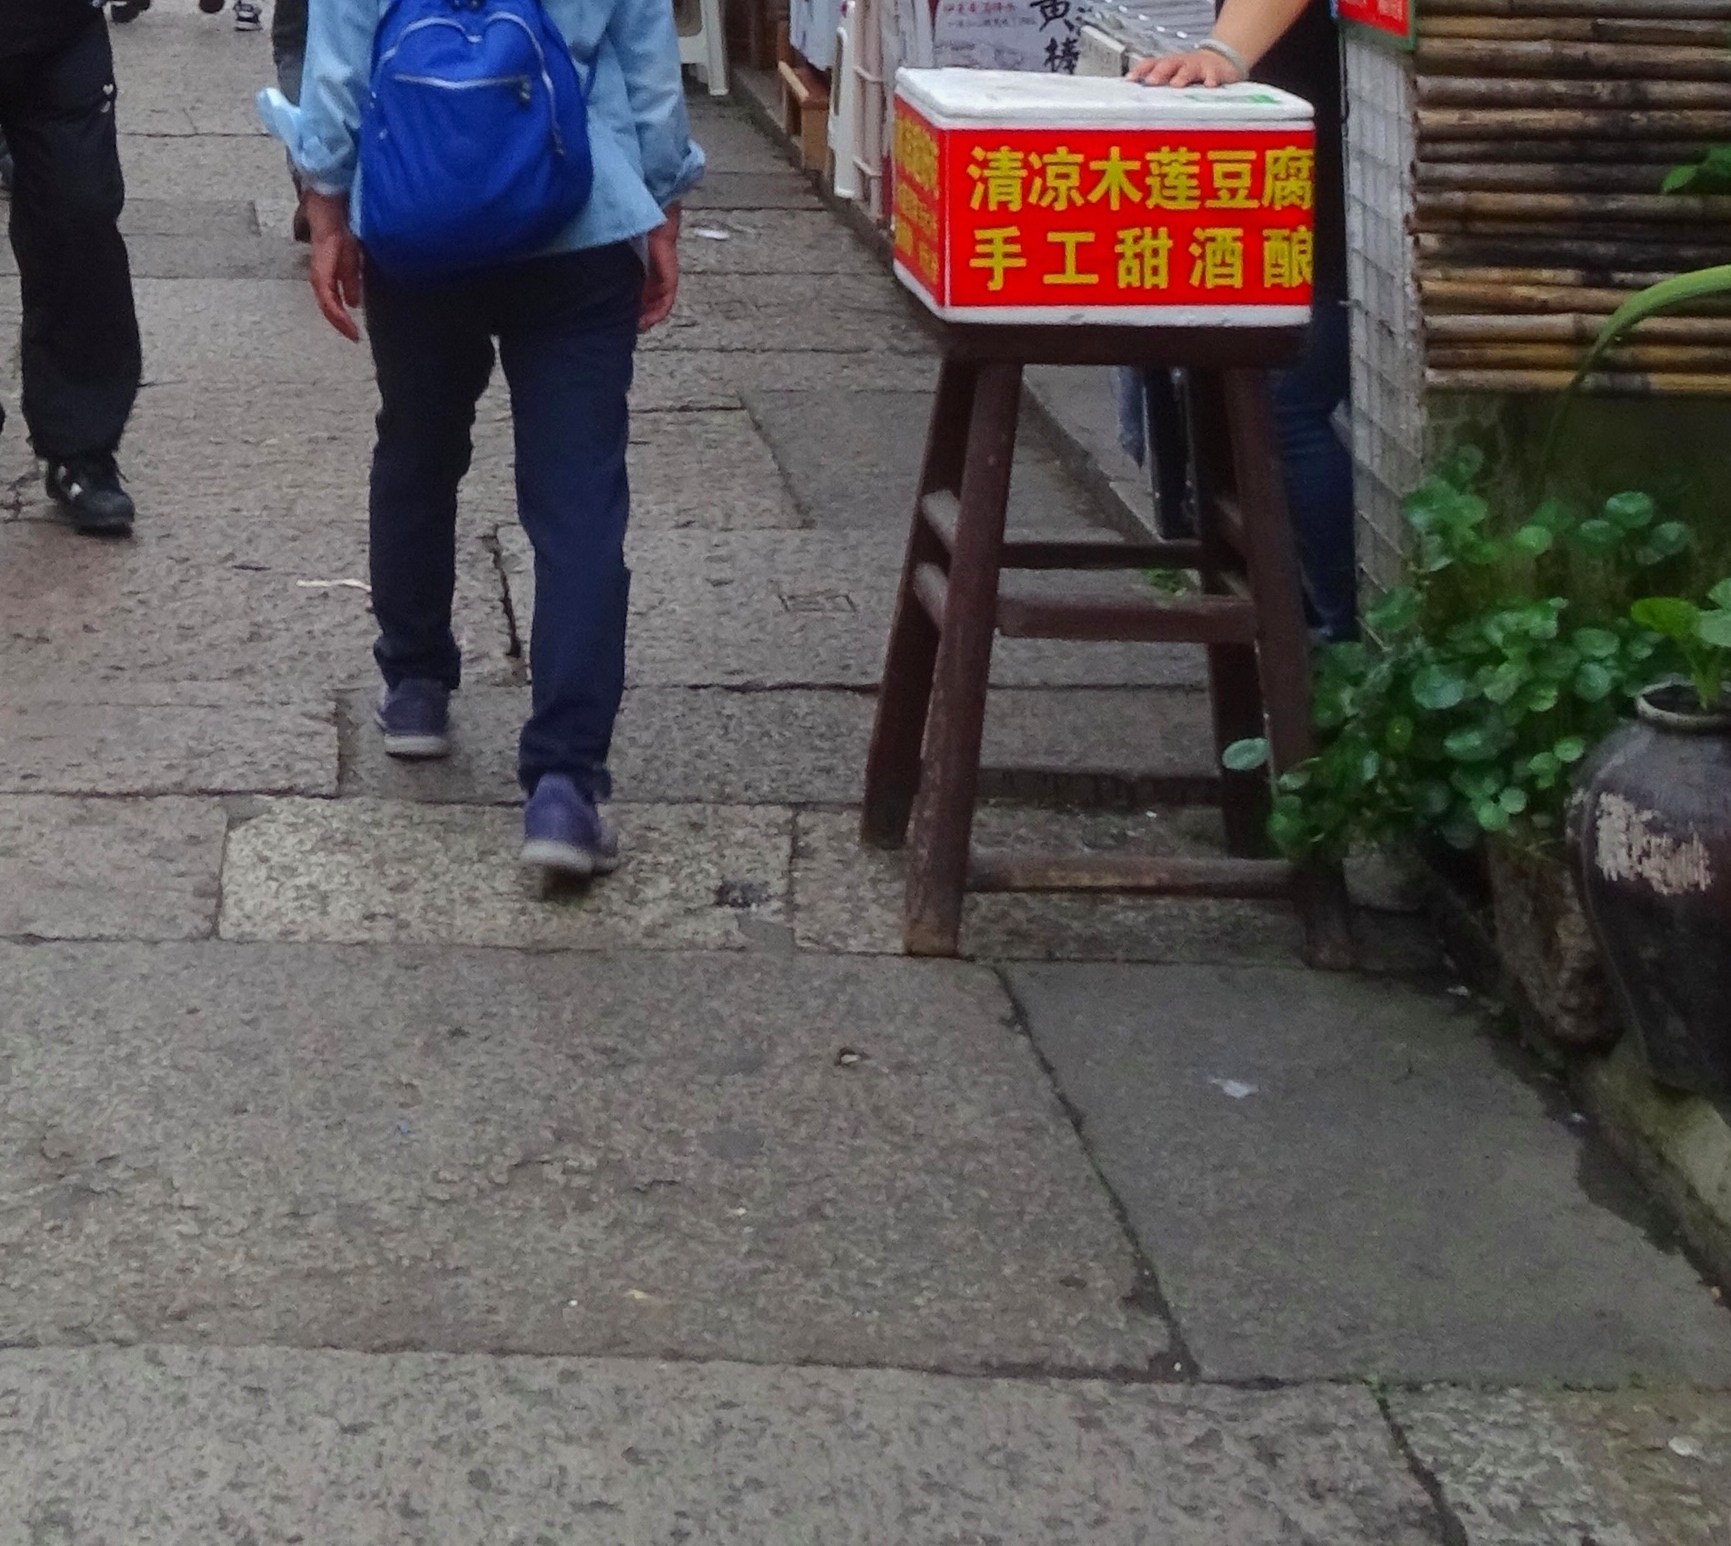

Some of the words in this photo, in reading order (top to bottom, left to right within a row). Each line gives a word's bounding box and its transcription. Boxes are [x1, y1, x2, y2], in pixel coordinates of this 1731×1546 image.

[966, 145, 1315, 211] 清凉木莲豆腐
[969, 225, 1314, 291] 手工甜酒酿
